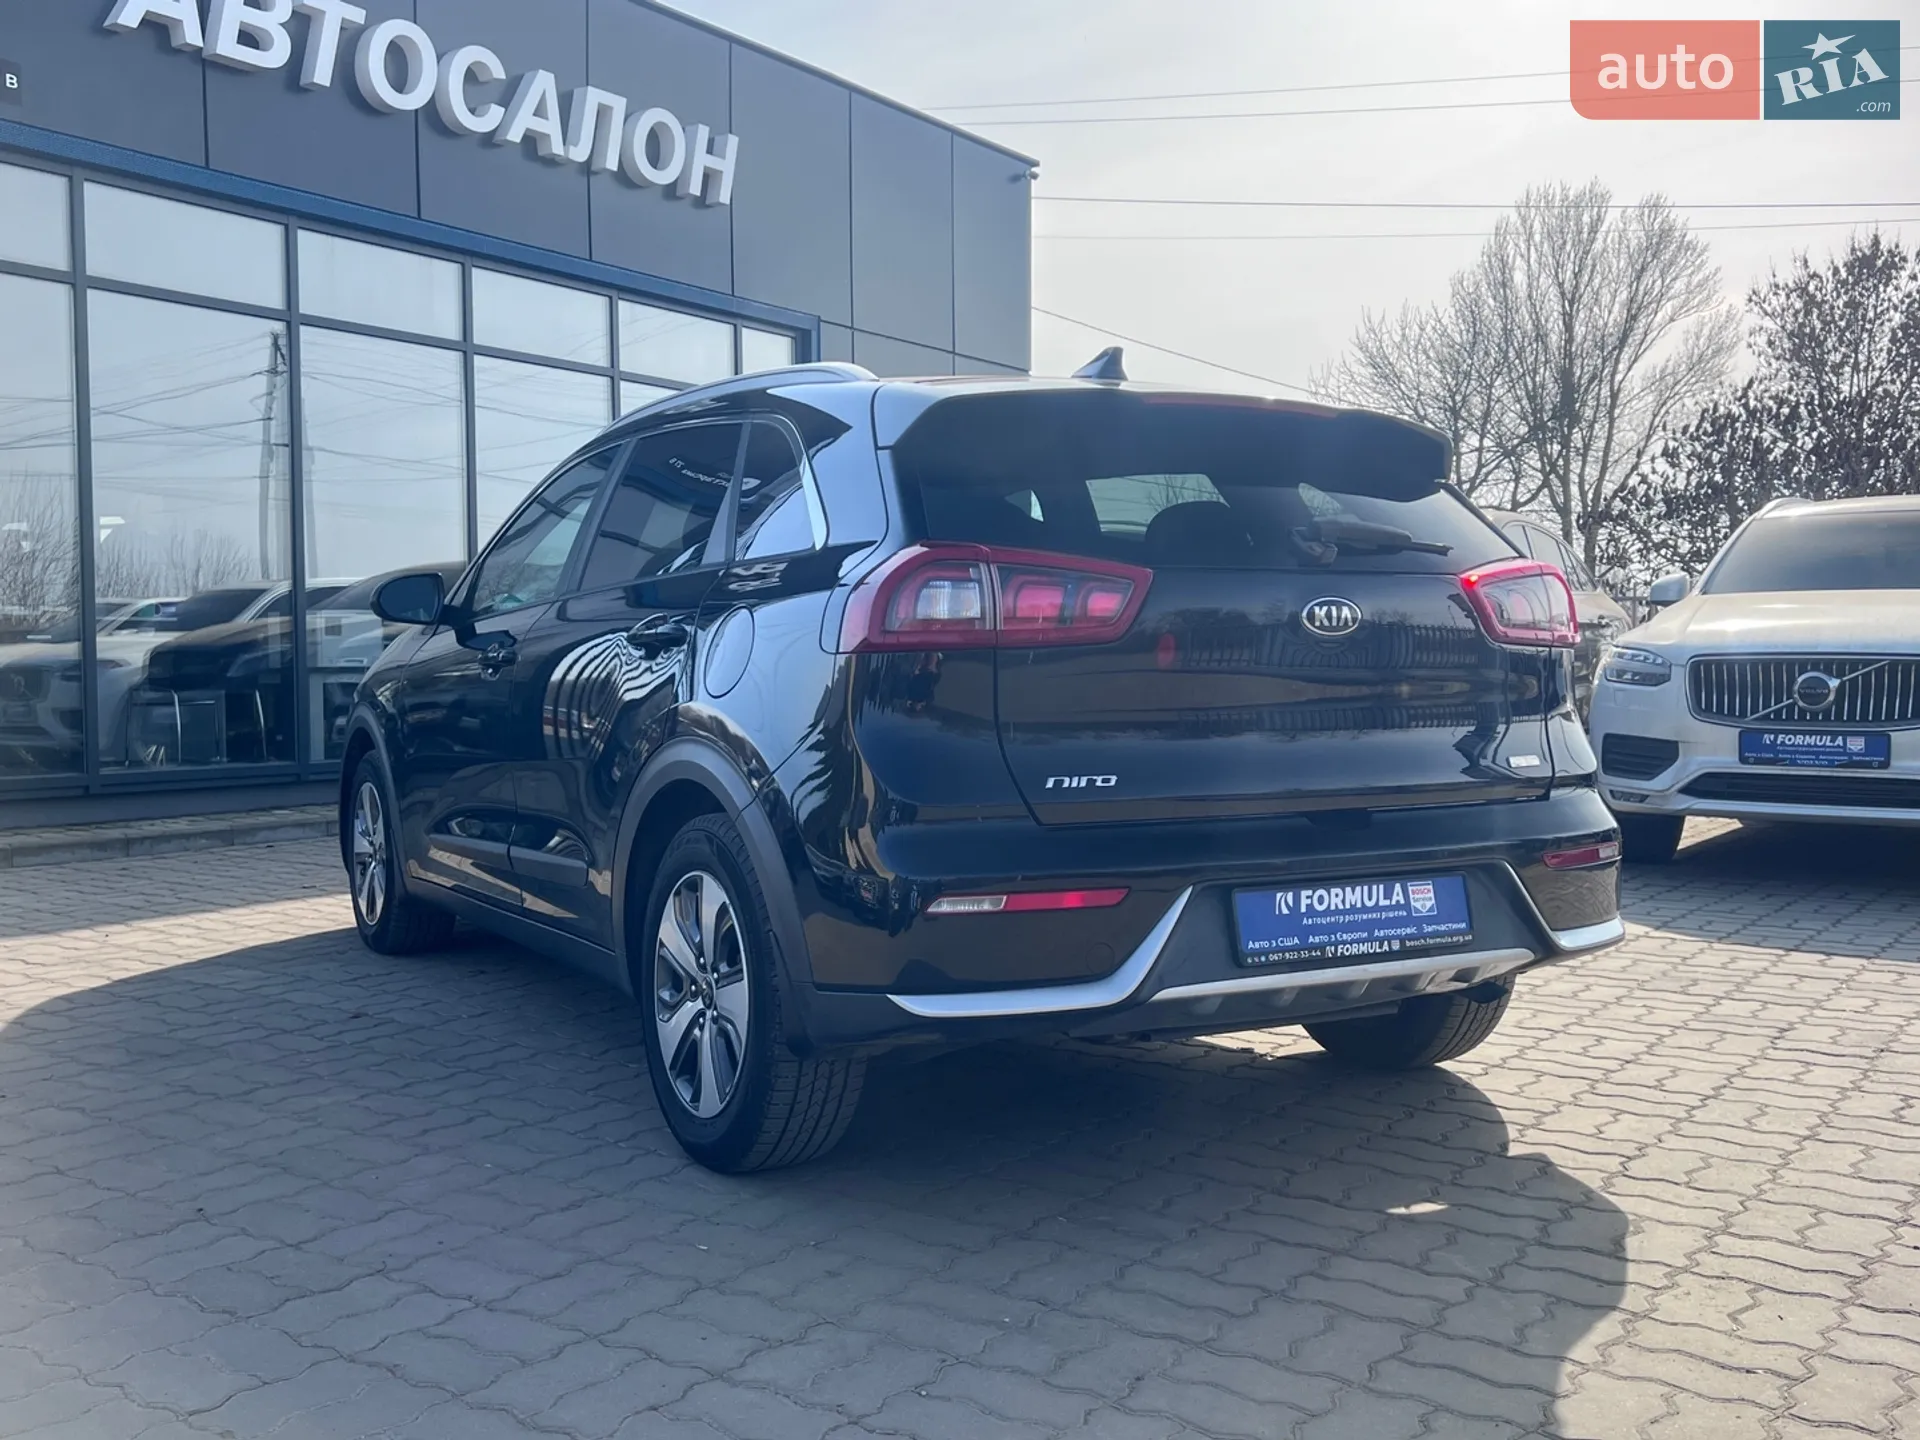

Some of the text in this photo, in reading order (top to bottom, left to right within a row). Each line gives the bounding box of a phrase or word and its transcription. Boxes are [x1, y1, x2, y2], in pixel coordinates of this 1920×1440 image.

[1314, 605, 1355, 627] KIA
[1776, 733, 1844, 747] FORMULA
[1300, 882, 1405, 913] FORMULA
[1302, 913, 1344, 926] Автоцентр
[1381, 909, 1408, 920] рішень
[1373, 924, 1418, 937] Автосервіс
[1422, 921, 1467, 933] Запчастини
[1247, 940, 1269, 949] Авто
[1277, 936, 1300, 946] США
[1308, 934, 1329, 943] Авто
[1336, 931, 1368, 943] Європи
[1337, 940, 1390, 956] FORMULA
